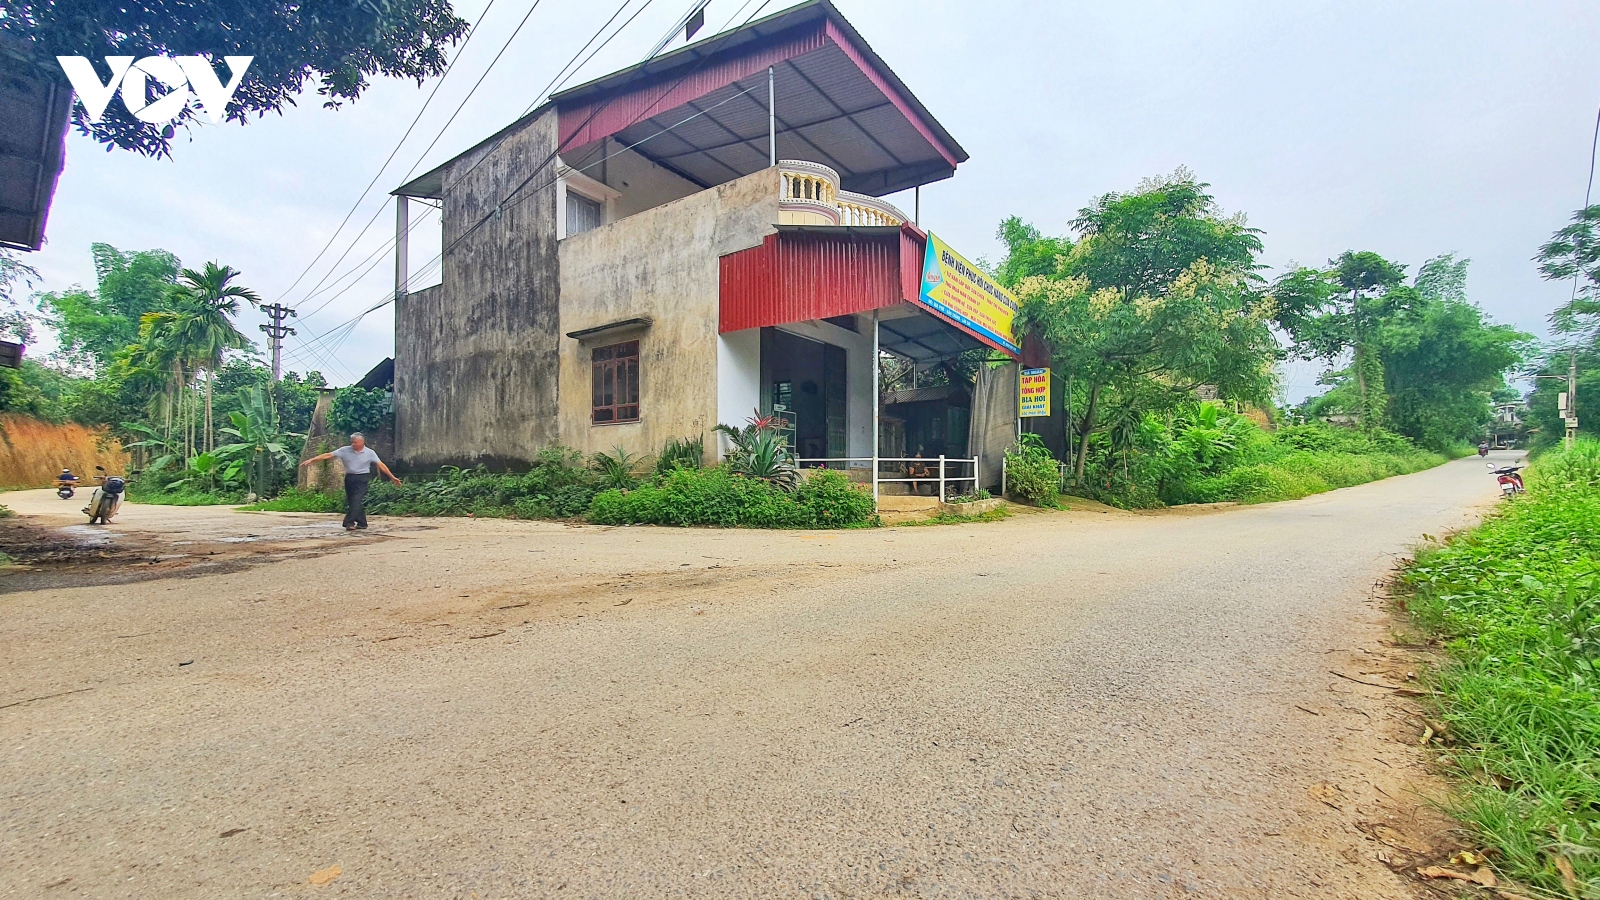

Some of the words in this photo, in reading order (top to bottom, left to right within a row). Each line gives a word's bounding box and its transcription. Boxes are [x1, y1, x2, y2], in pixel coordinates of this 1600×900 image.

[942, 250, 954, 268] BỆNH
[955, 260, 965, 276] VIỆN
[966, 268, 976, 284] PHỤC
[1022, 386, 1034, 394] TỔNG
[1036, 386, 1046, 395] HỢP
